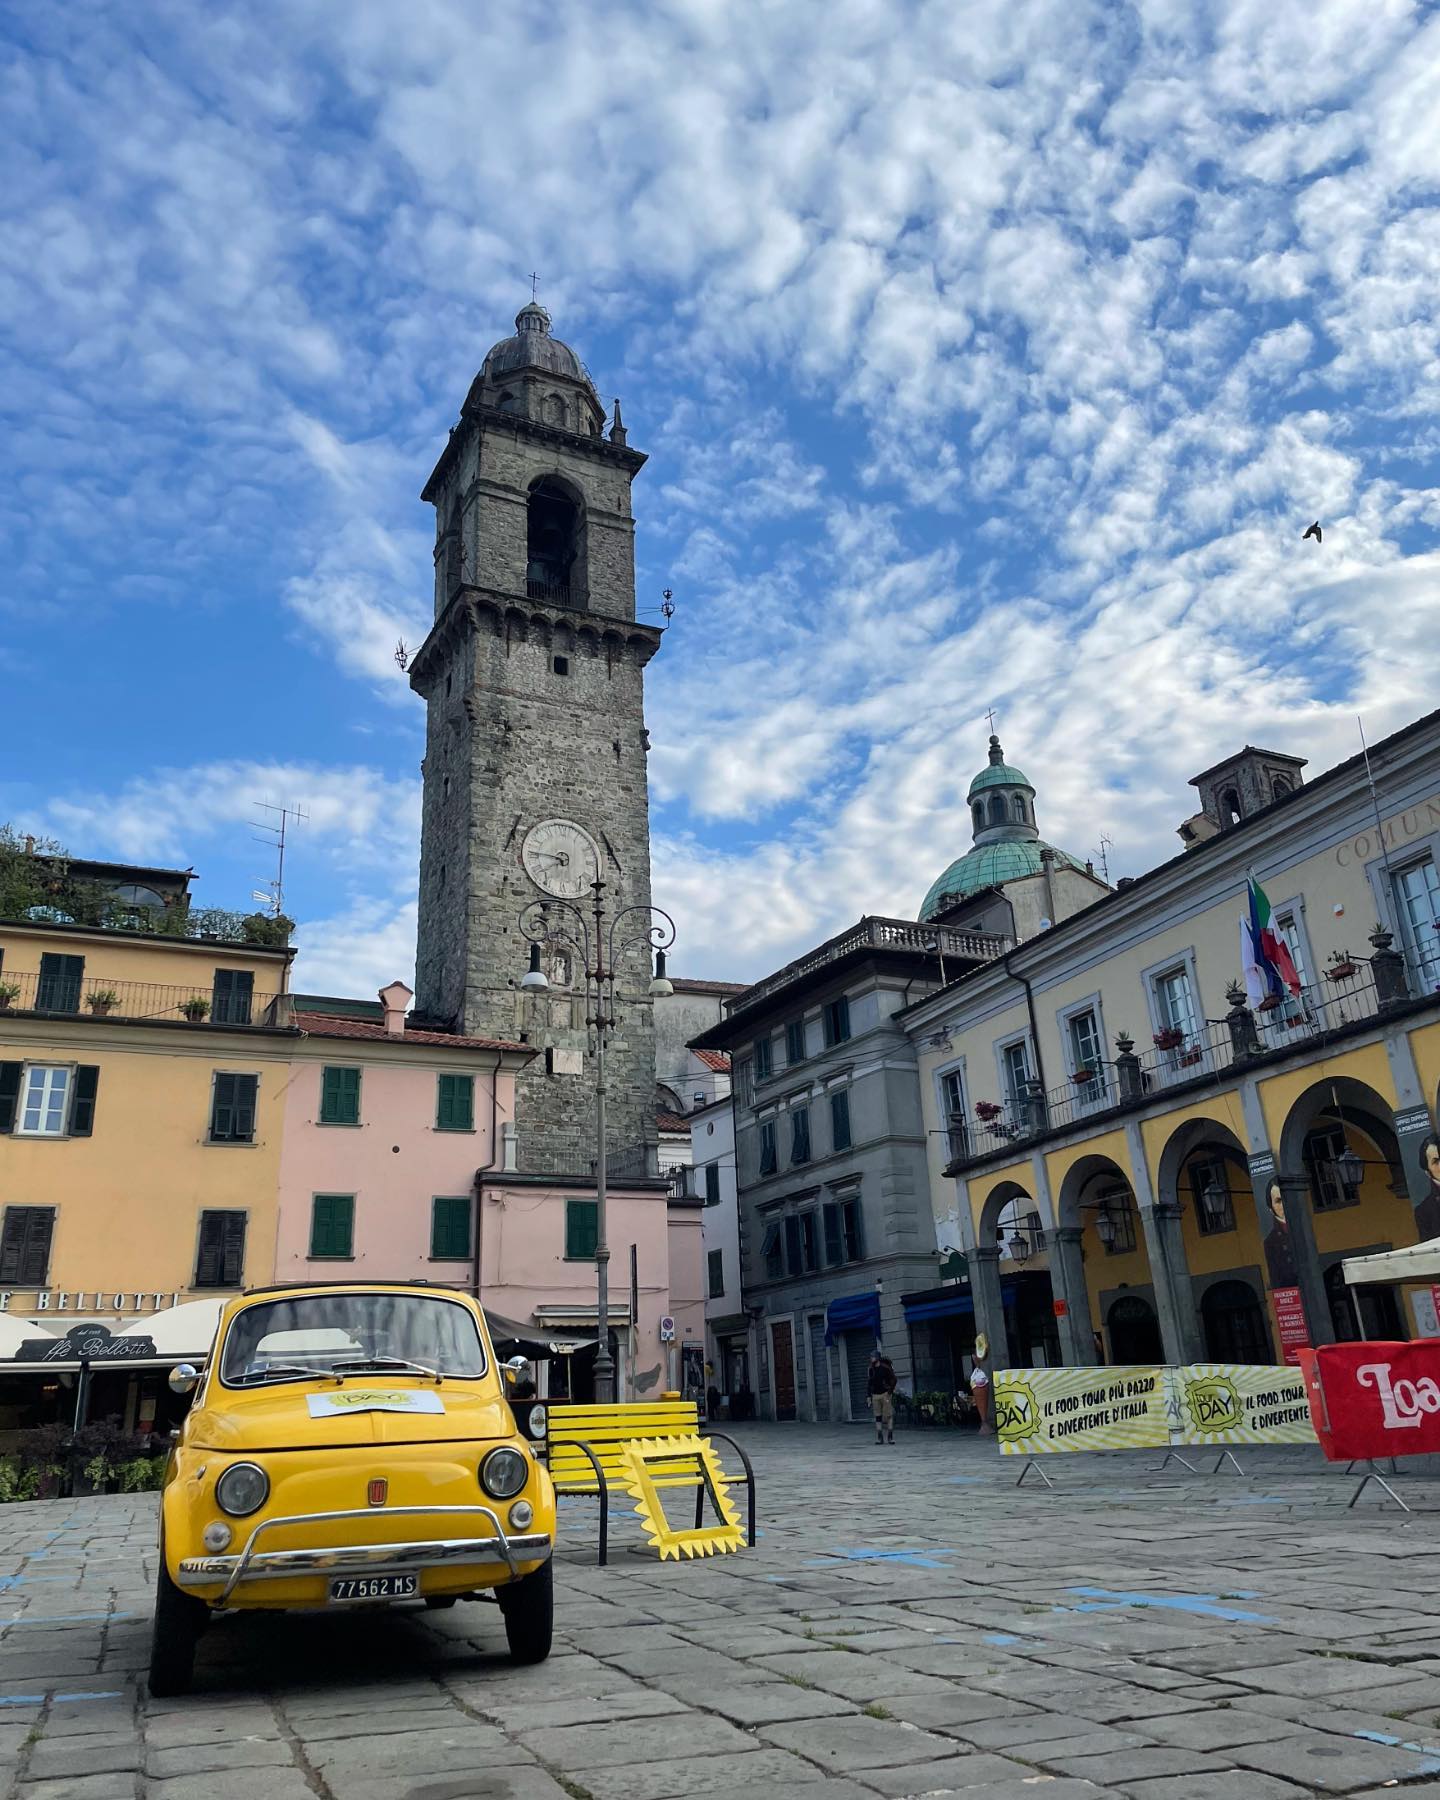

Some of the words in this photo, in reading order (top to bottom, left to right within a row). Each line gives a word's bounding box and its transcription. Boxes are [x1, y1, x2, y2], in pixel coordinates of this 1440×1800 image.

[37, 1292, 179, 1311] BELLOTTI
[78, 1337, 149, 1356] Bellotti
[1044, 1403, 1054, 1417] IL
[1055, 1397, 1079, 1414] FOOD
[1081, 1390, 1106, 1408] TOUR
[1109, 1380, 1124, 1401] PIÙ
[1127, 1377, 1154, 1397] PAZZO
[1198, 1395, 1232, 1422] DAY
[1246, 1395, 1255, 1410] IL
[1257, 1392, 1279, 1408] FOOD
[1281, 1386, 1304, 1404] TOUR
[995, 1401, 1029, 1430] DAY
[1049, 1424, 1055, 1439] E
[1057, 1410, 1110, 1437] DIVERTENTE
[1112, 1400, 1148, 1423] D'ITALIA
[1251, 1416, 1257, 1430] E
[1259, 1406, 1309, 1428] DIVERTENTE
[336, 1579, 389, 1598] 77562
[394, 1577, 414, 1594] MS
